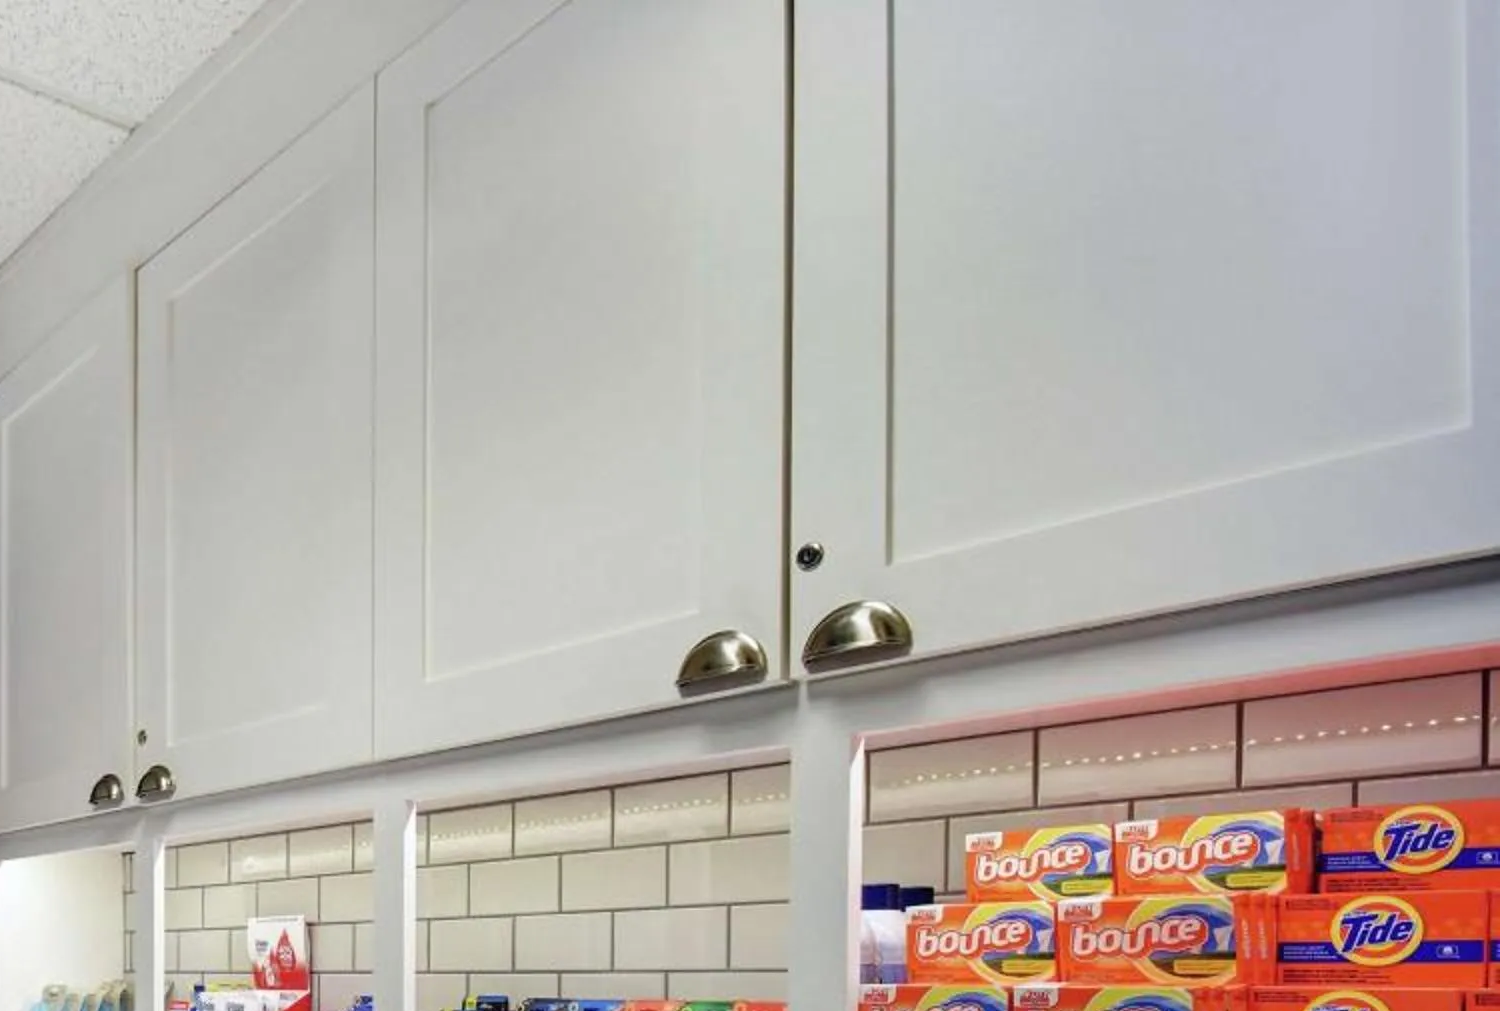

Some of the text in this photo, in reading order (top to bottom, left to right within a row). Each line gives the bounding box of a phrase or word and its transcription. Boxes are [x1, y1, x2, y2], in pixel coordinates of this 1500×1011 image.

[1130, 832, 1254, 876] bounce
[1383, 823, 1455, 861] Tide
[977, 844, 1086, 883] bounce
[918, 921, 1029, 957] bounce
[1073, 916, 1204, 957] bounce
[1341, 914, 1414, 953] Tide
